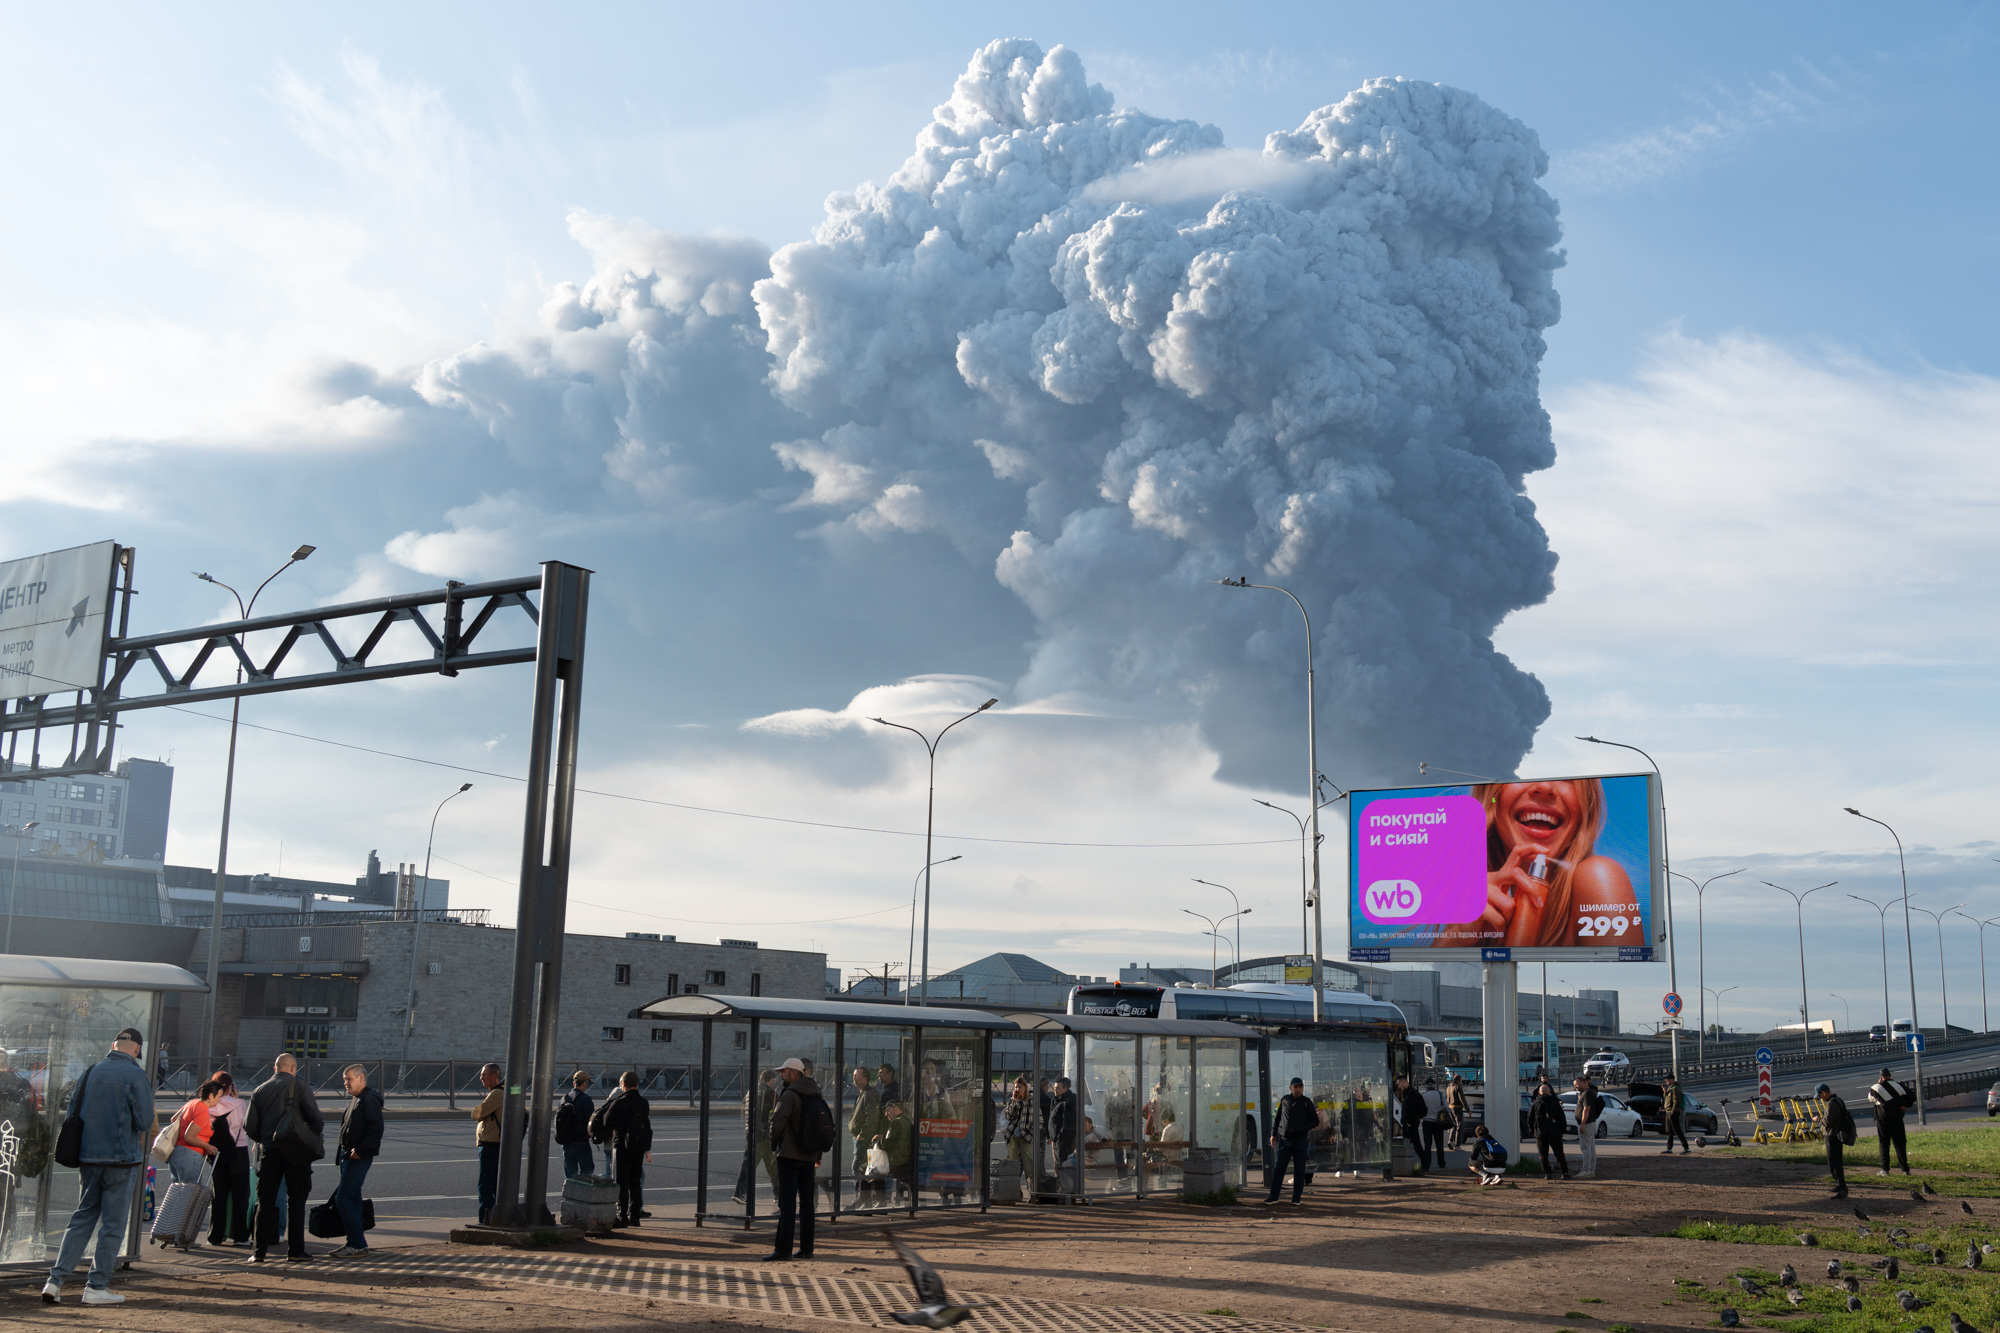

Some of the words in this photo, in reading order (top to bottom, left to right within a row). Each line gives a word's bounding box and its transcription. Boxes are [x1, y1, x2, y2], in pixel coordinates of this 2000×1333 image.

[2, 639, 34, 656] метро
[1370, 808, 1447, 829] покупай
[1370, 834, 1381, 846] и
[1385, 828, 1429, 846] сияй
[1371, 882, 1415, 910] wb
[1579, 903, 1626, 914] шиммер
[1628, 903, 1641, 911] от
[1577, 915, 1629, 937] 299
[1358, 932, 1367, 940] ООО
[1083, 1005, 1116, 1015] PRESTIGE
[1130, 1007, 1148, 1016] BUS
[945, 1060, 971, 1069] ПРОЕКТЫ
[950, 1069, 971, 1078] РОССИИ
[919, 1120, 931, 1134] 67
